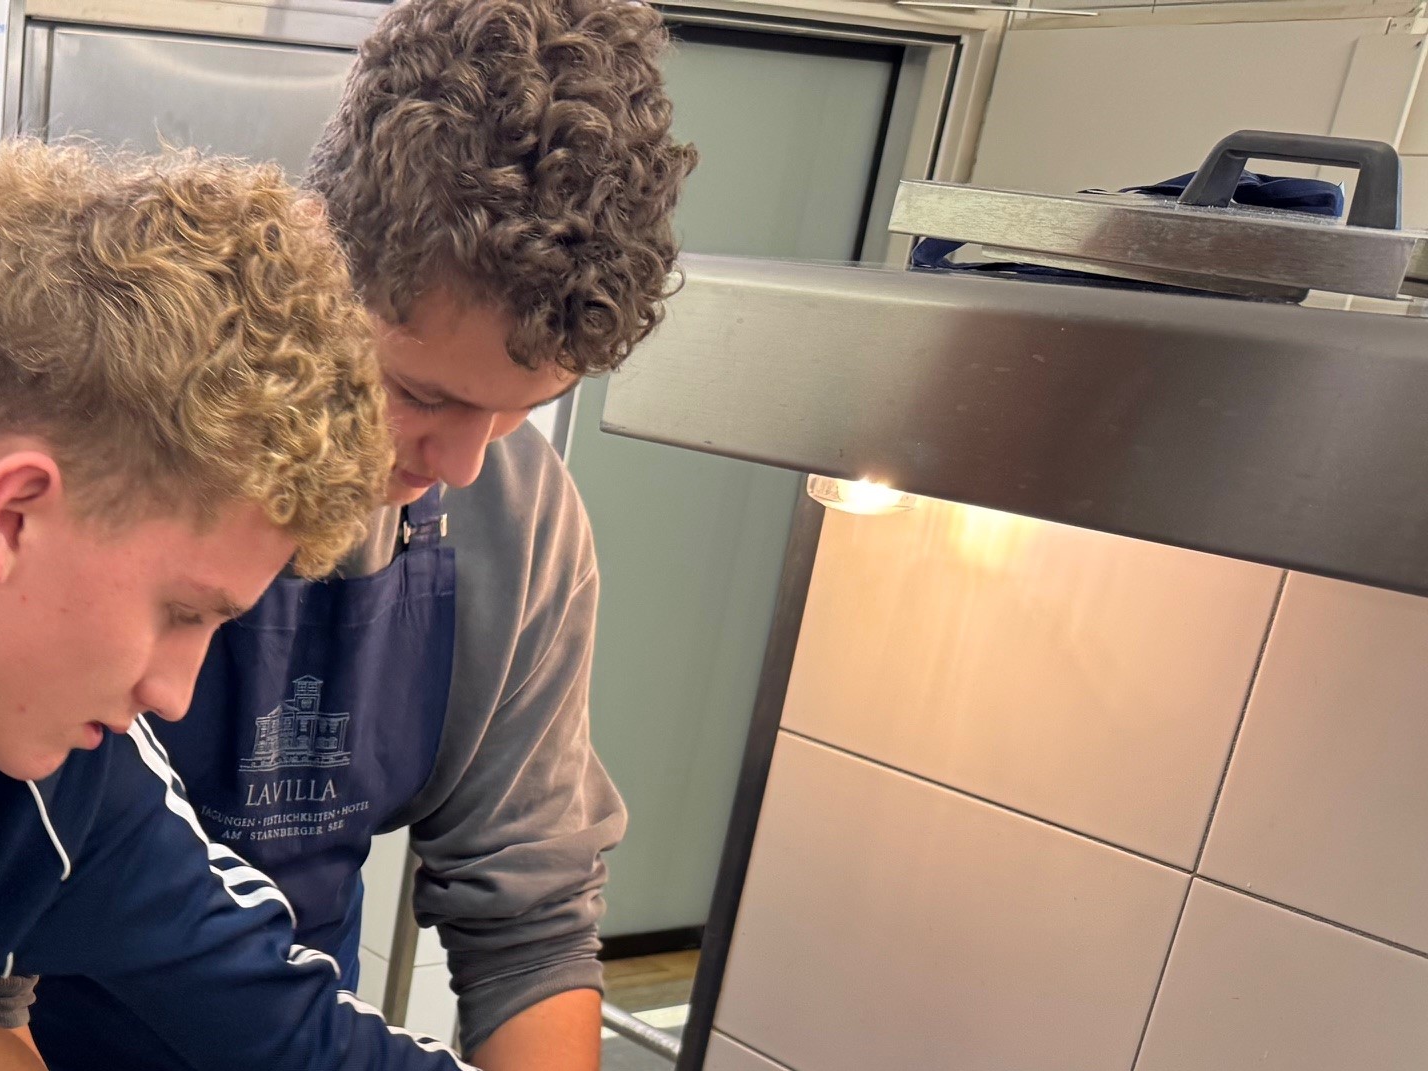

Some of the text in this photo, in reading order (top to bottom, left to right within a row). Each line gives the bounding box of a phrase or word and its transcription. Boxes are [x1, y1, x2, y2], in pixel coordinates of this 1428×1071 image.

[221, 820, 345, 841] AM STARNBERGER SEE
